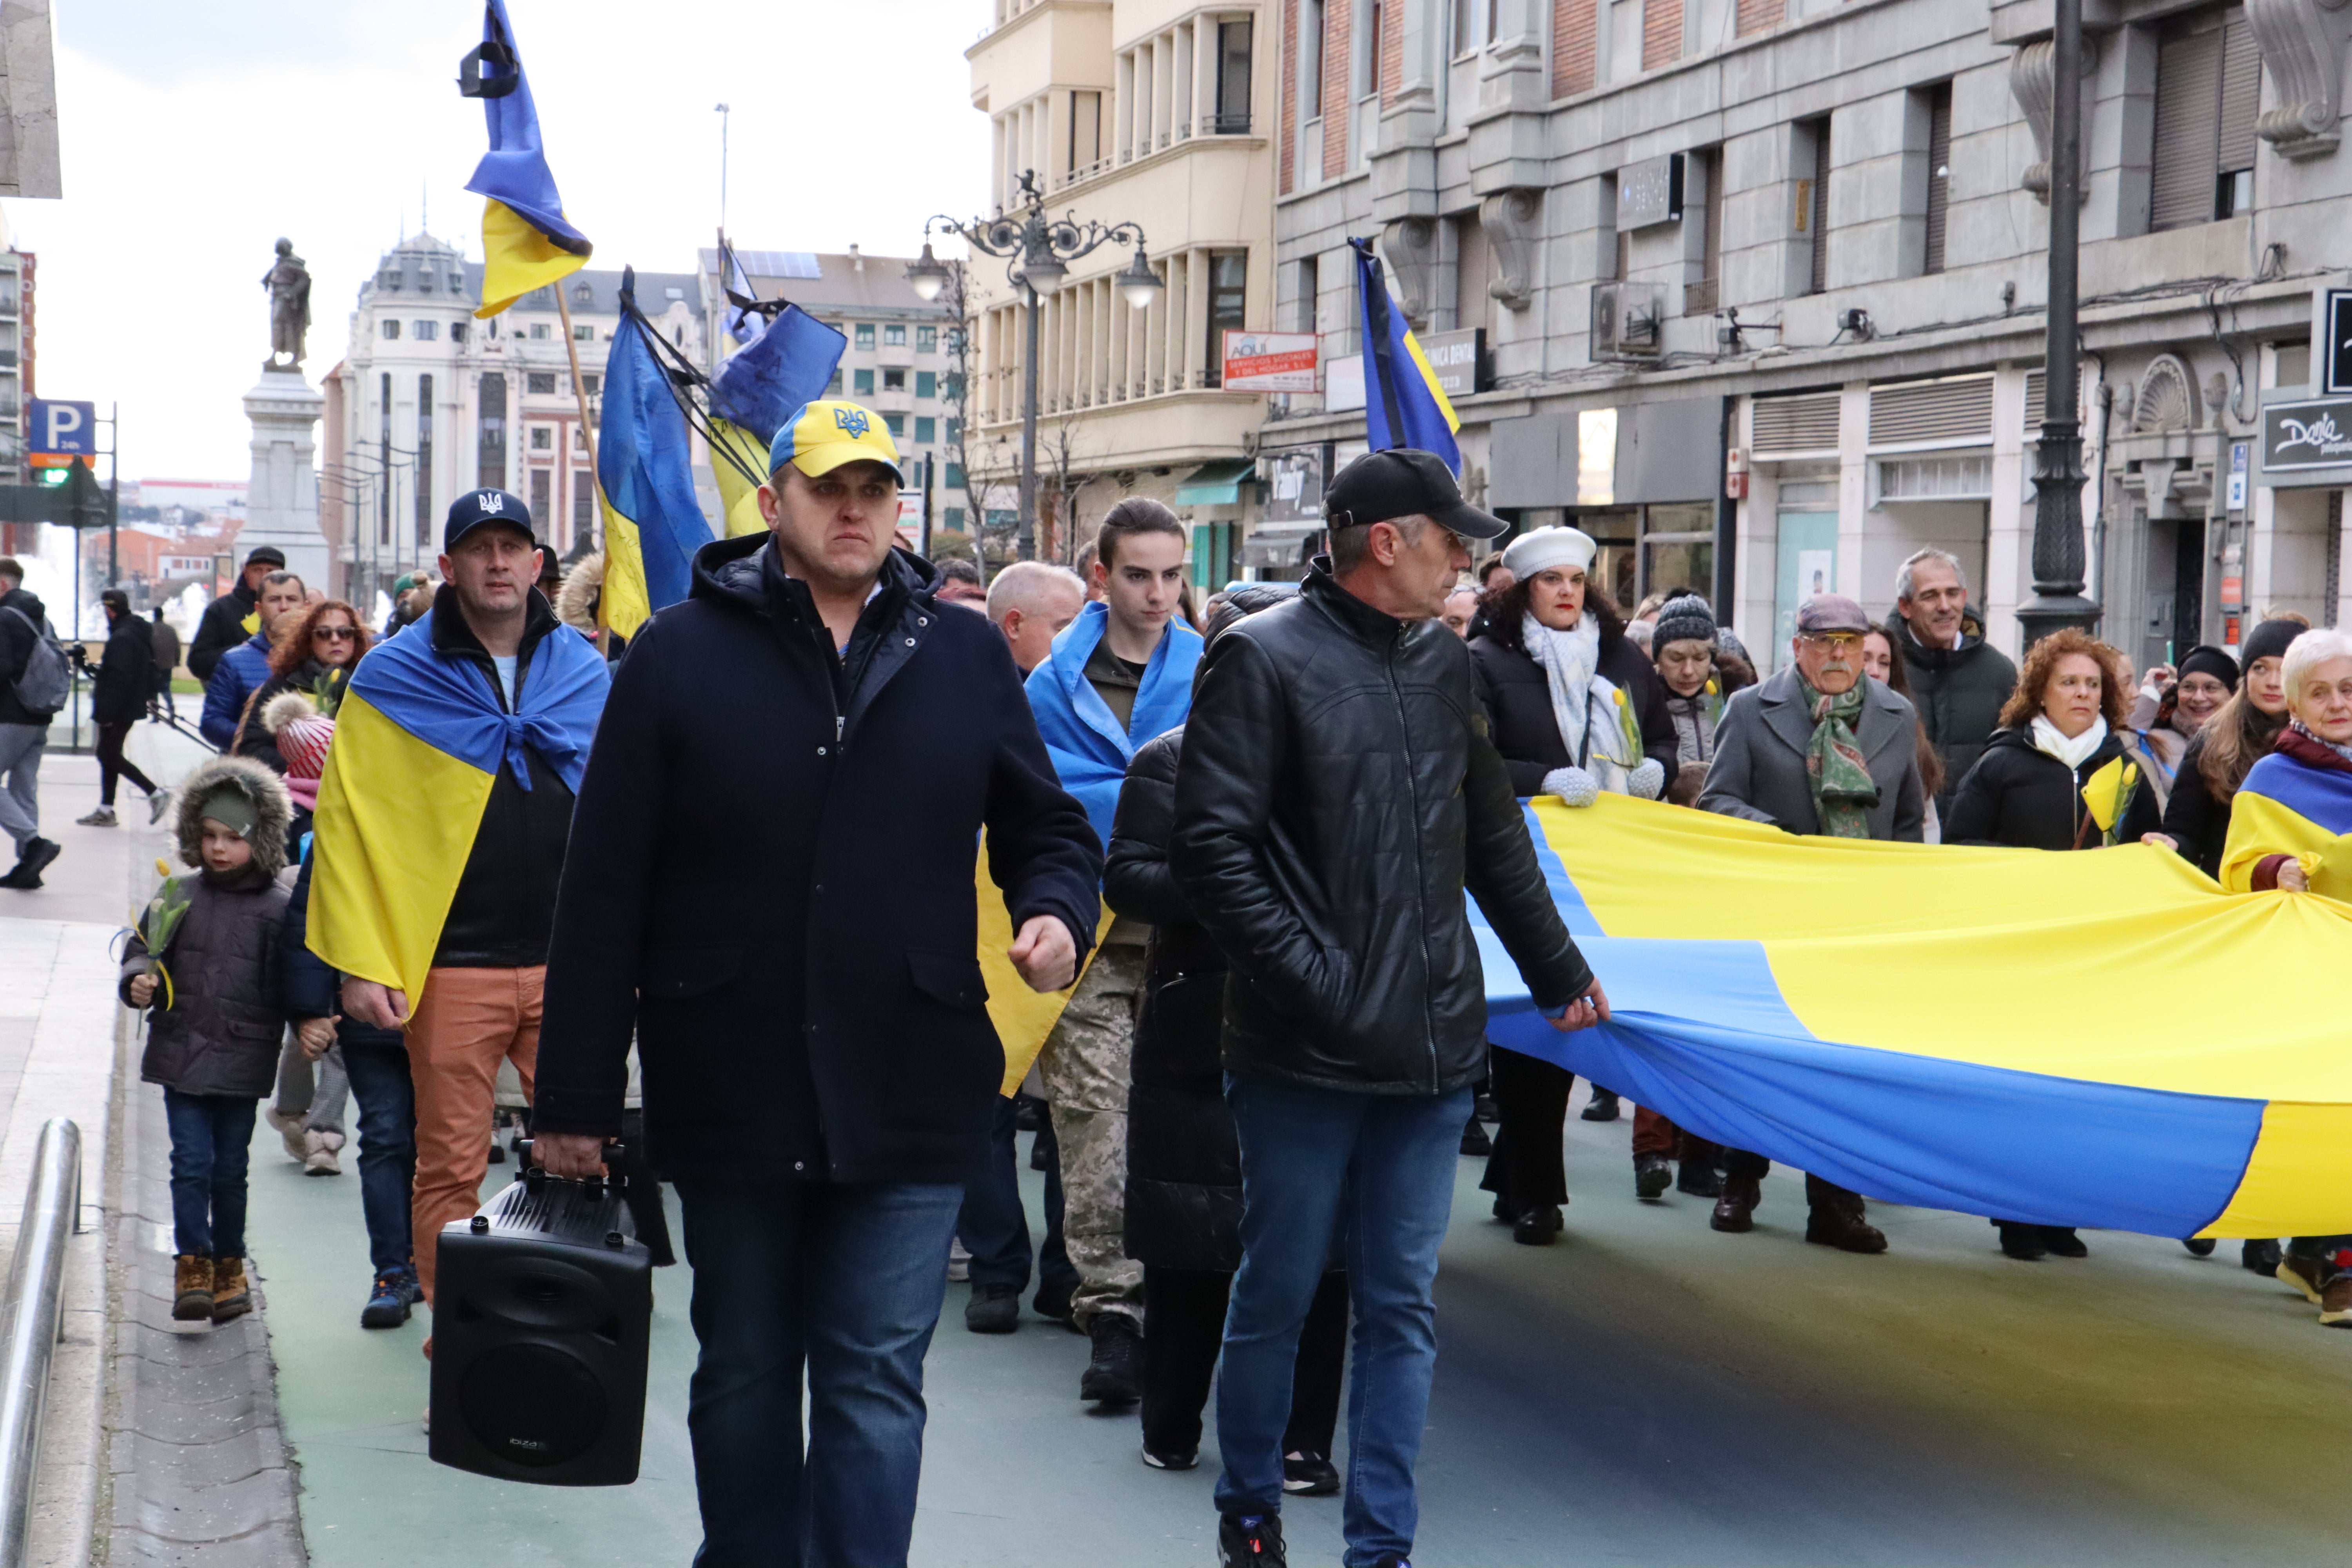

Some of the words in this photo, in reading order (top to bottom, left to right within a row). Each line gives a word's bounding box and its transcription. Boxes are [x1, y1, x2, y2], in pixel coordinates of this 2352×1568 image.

[1229, 356, 1271, 369] SERVICIOS
[1273, 351, 1312, 363] SOCIALES
[47, 404, 81, 449] P
[510, 1438, 537, 1447] ibiza
